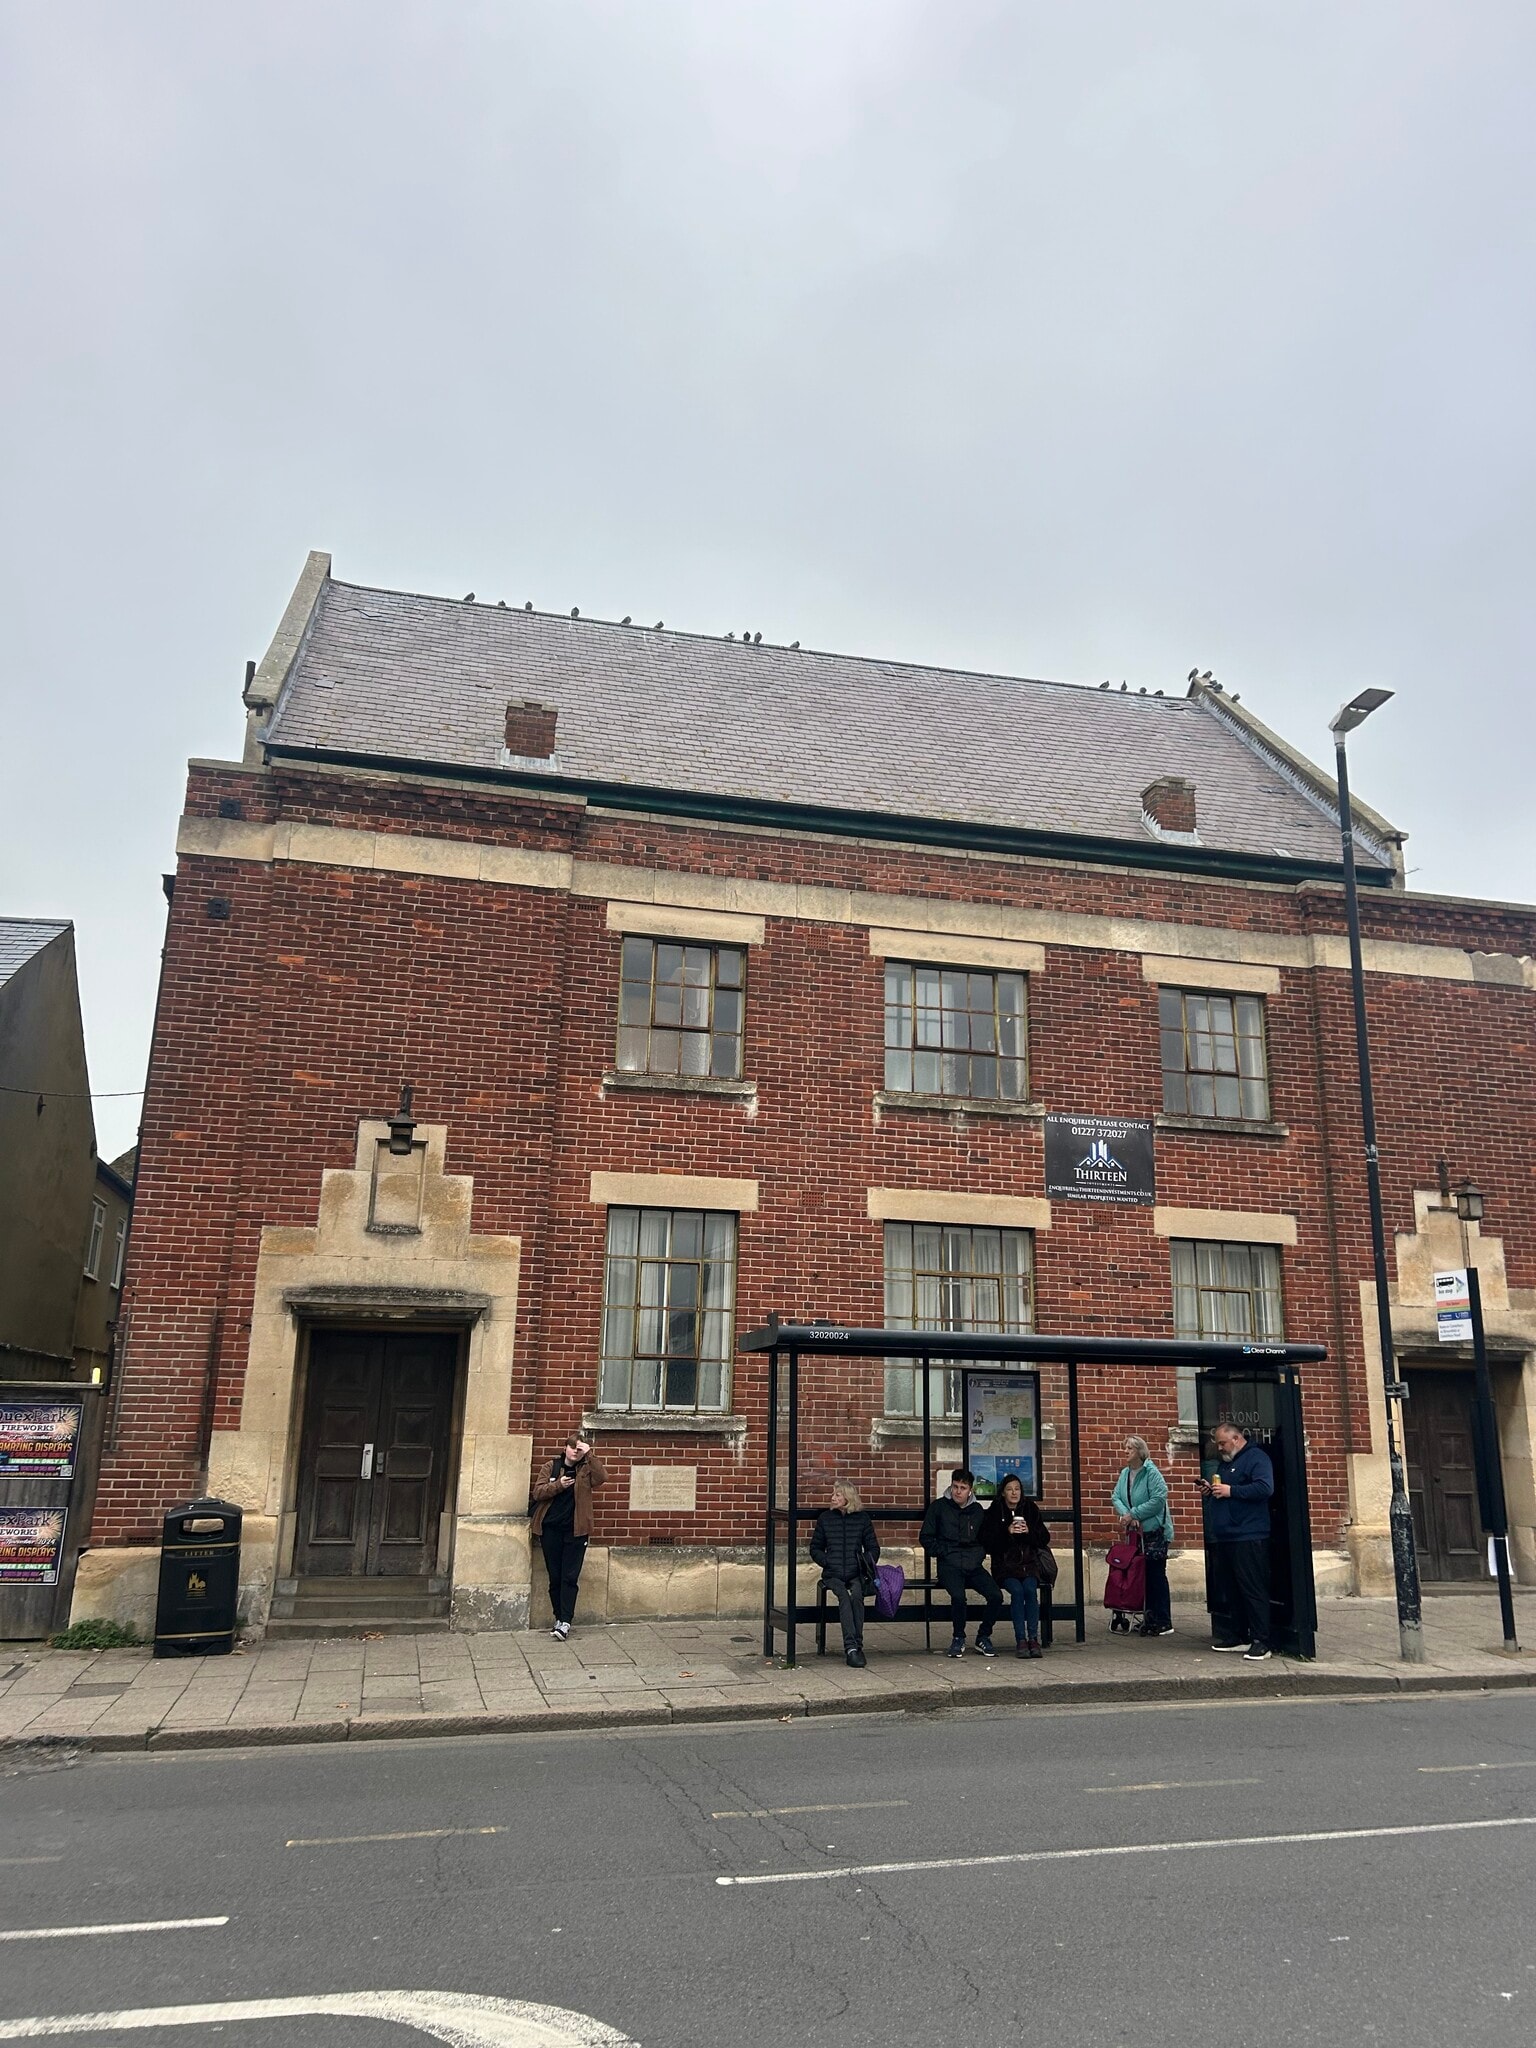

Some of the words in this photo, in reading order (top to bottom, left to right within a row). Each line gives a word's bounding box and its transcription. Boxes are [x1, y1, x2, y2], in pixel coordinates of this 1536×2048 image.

[1059, 1117, 1094, 1125] ENQUIRIES
[1118, 1122, 1150, 1130] CONTACT
[1072, 1127, 1095, 1136] 01227
[1097, 1129, 1127, 1138] 372027
[1074, 1168, 1127, 1182] THIRTEEN
[810, 1331, 849, 1339] 32020024
[1220, 1411, 1260, 1423] BEYOND
[35, 1443, 72, 1452] DISPLAYS
[18, 1547, 56, 1556] DISPLAYS
